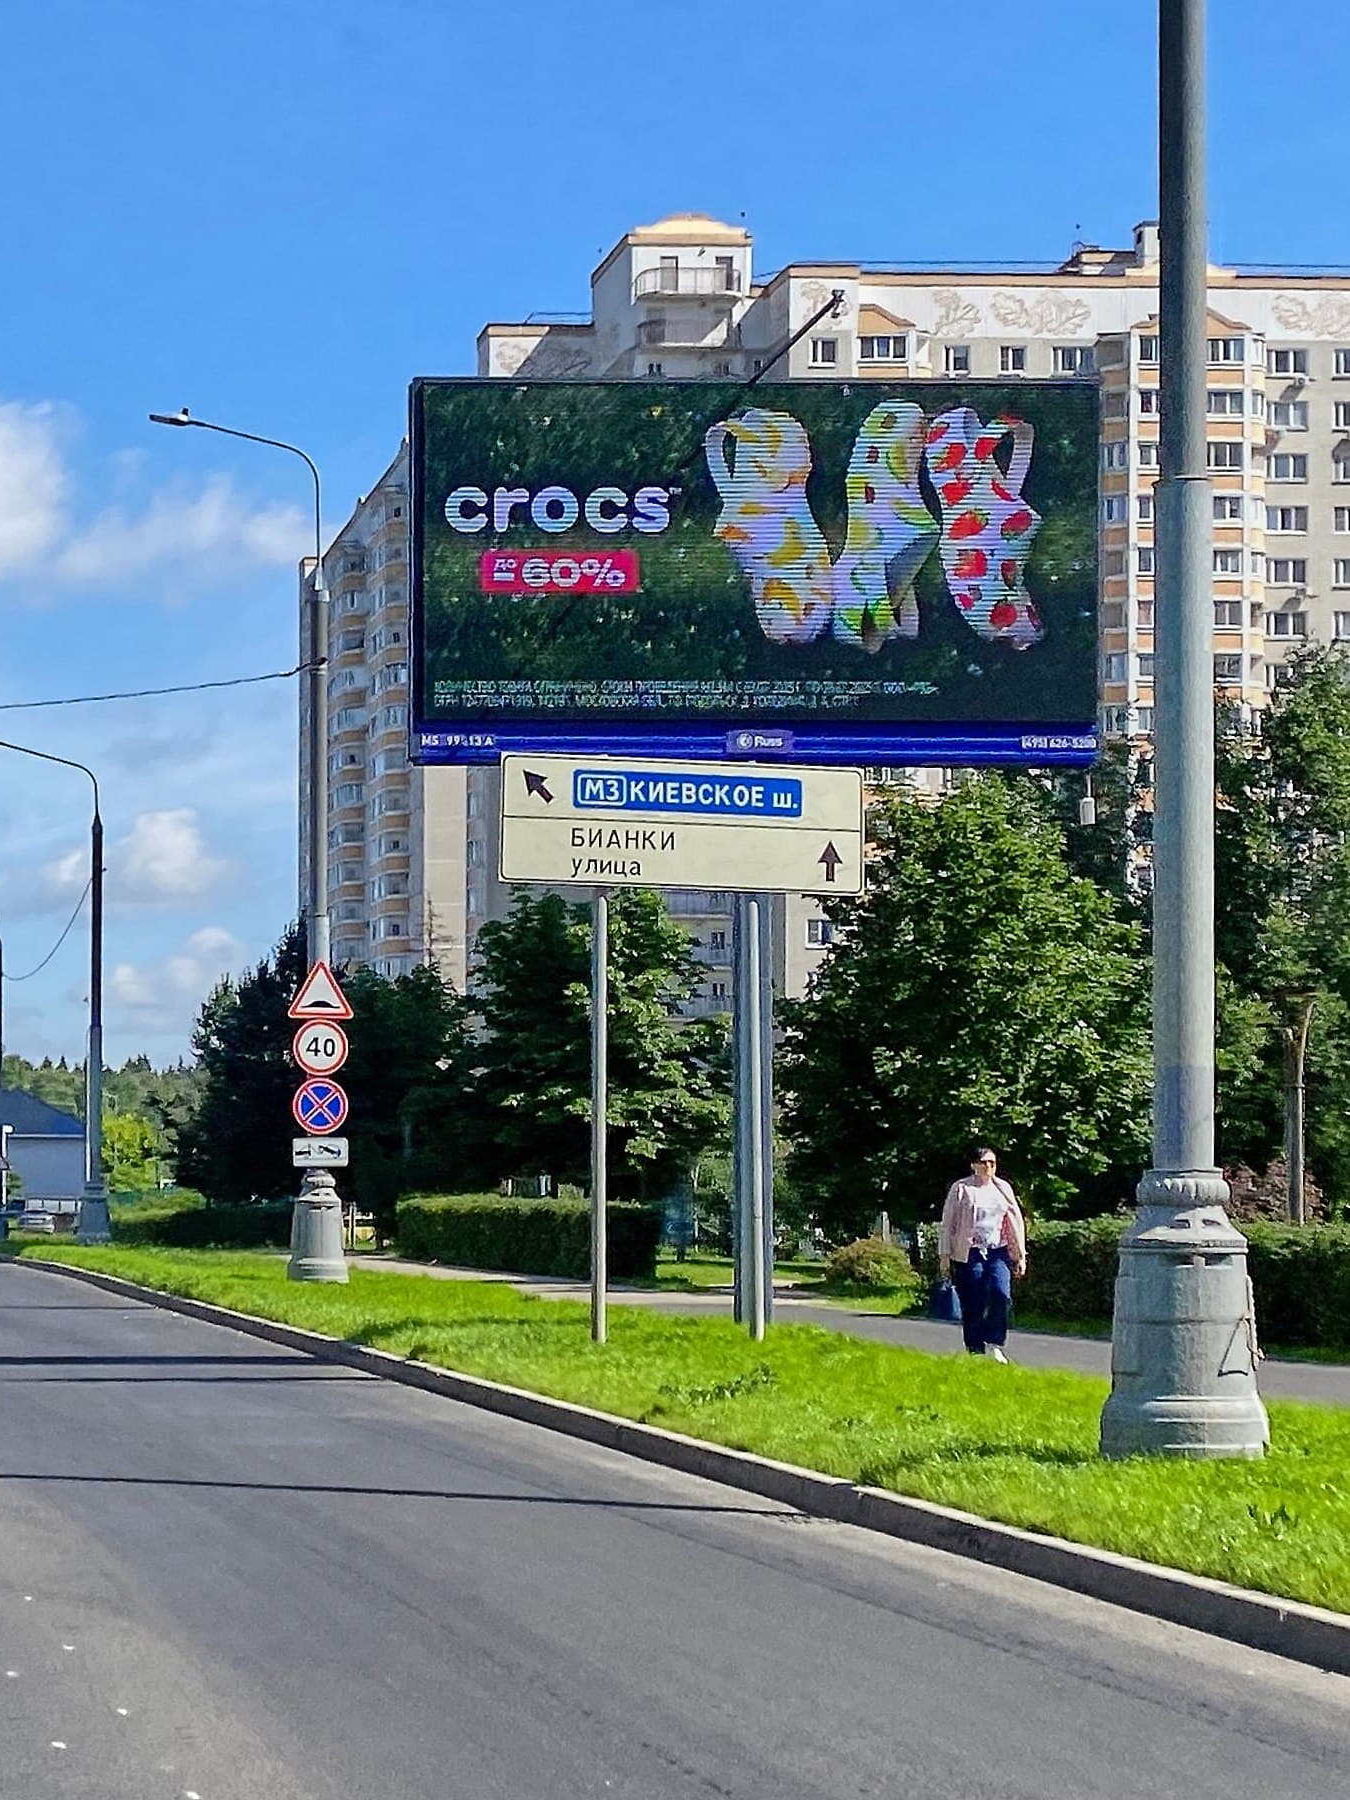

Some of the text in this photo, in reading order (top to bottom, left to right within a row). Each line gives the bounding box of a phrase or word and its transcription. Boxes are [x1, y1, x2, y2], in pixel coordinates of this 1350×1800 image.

[444, 485, 670, 533] crocs
[629, 780, 765, 808] КИЕВСКОЕ
[570, 827, 676, 851] БИАНКИ
[570, 857, 642, 878] улица
[305, 1036, 336, 1057] 40
